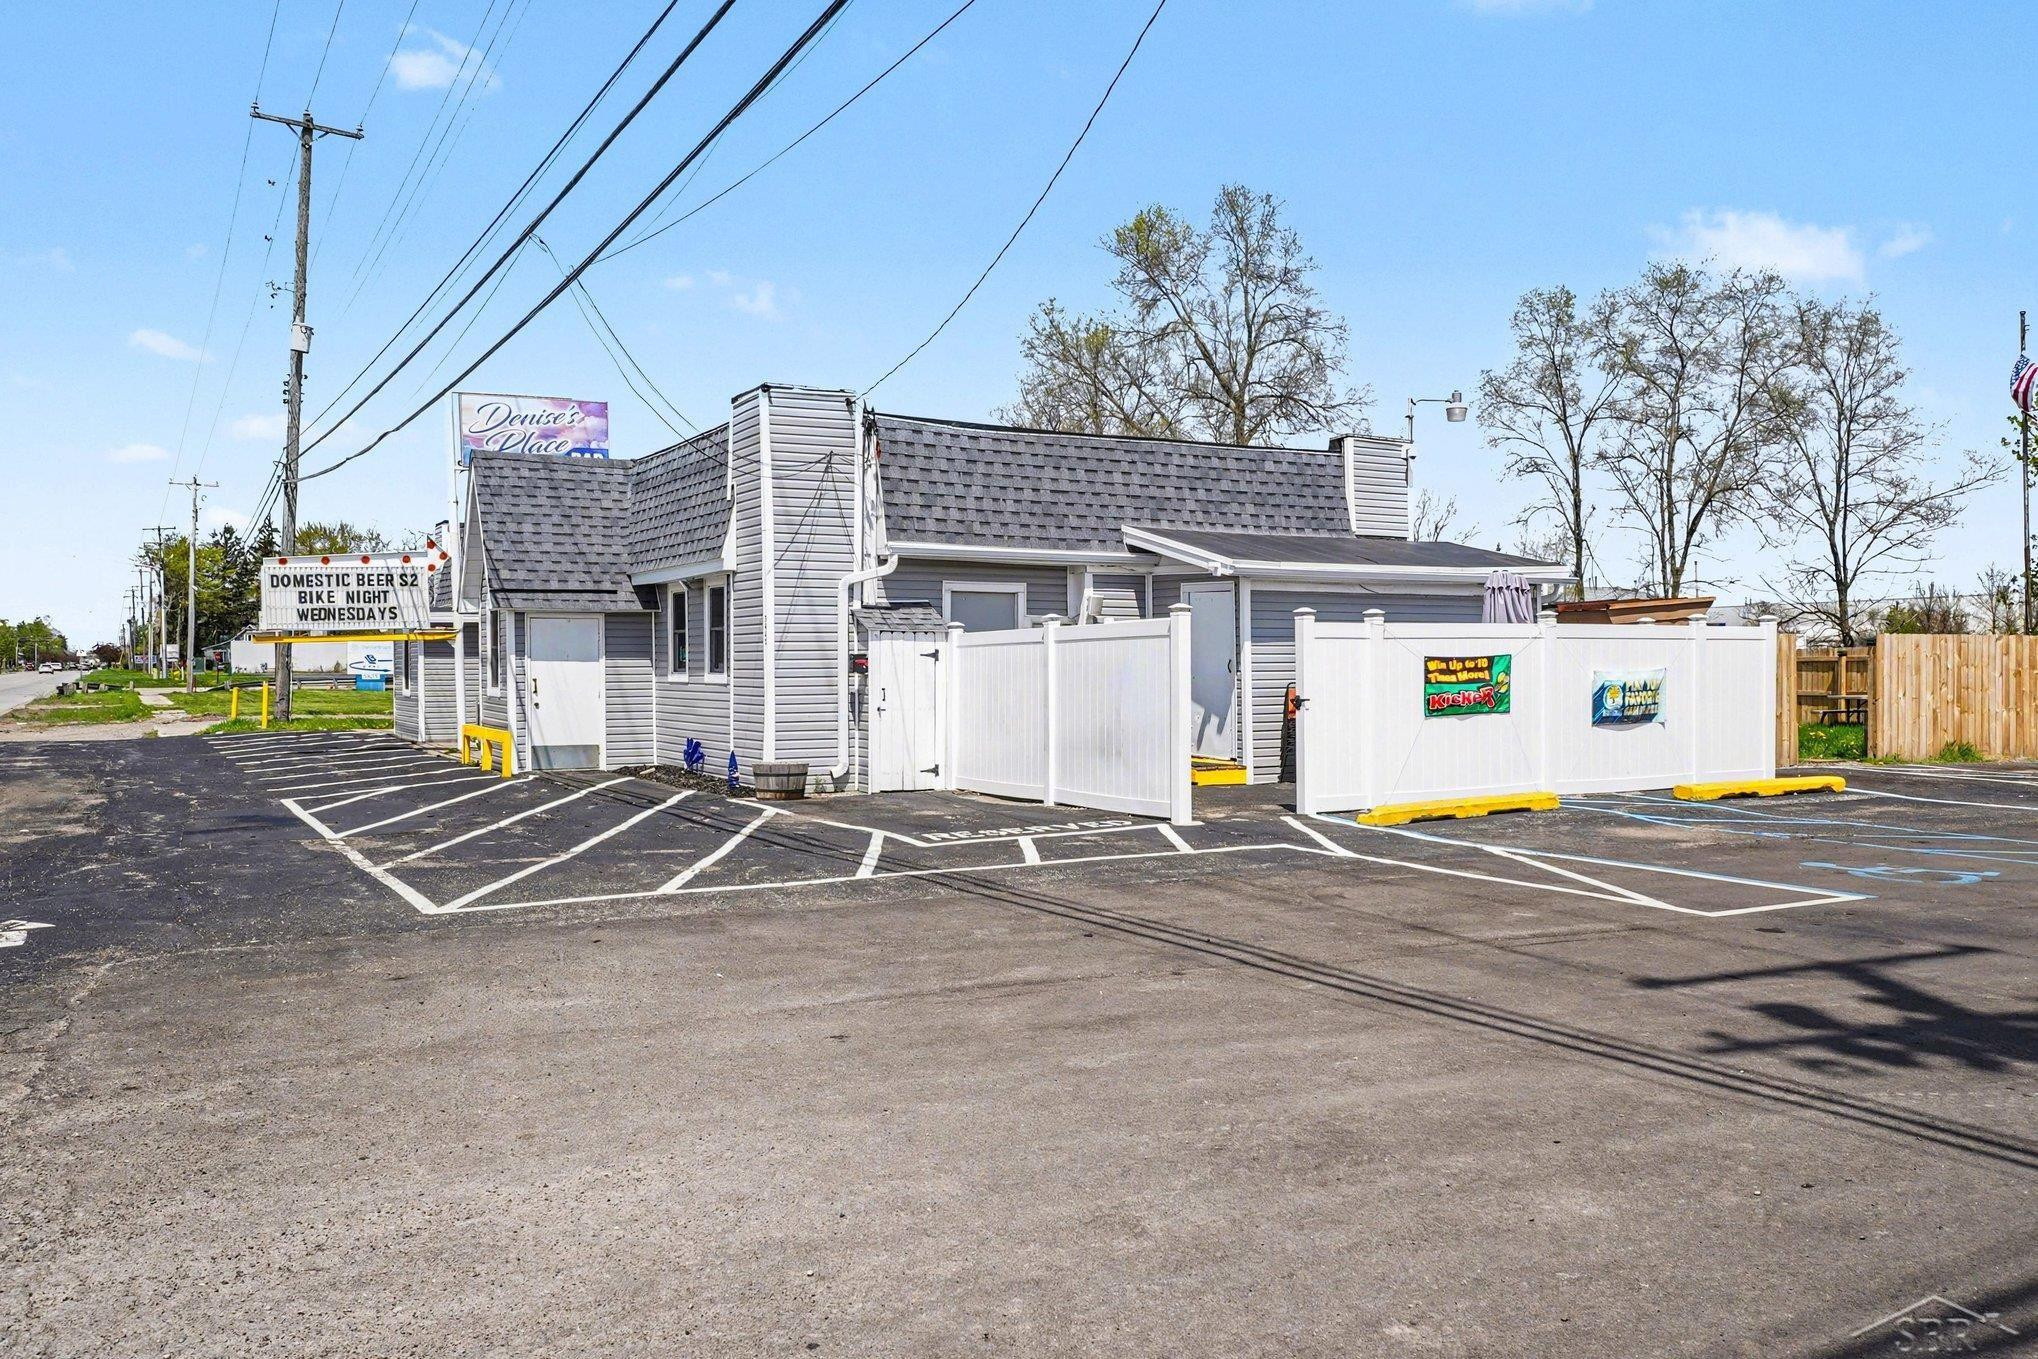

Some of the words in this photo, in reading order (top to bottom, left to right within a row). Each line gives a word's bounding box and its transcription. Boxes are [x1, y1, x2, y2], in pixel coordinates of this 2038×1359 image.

[468, 402, 581, 433] Denise's
[485, 429, 570, 454] Place
[270, 574, 350, 588] DOMESTIC
[356, 573, 395, 588] BEER
[299, 591, 336, 604] BIKE
[346, 590, 390, 604] NIGHT
[297, 606, 398, 622] WEDNESDAYS
